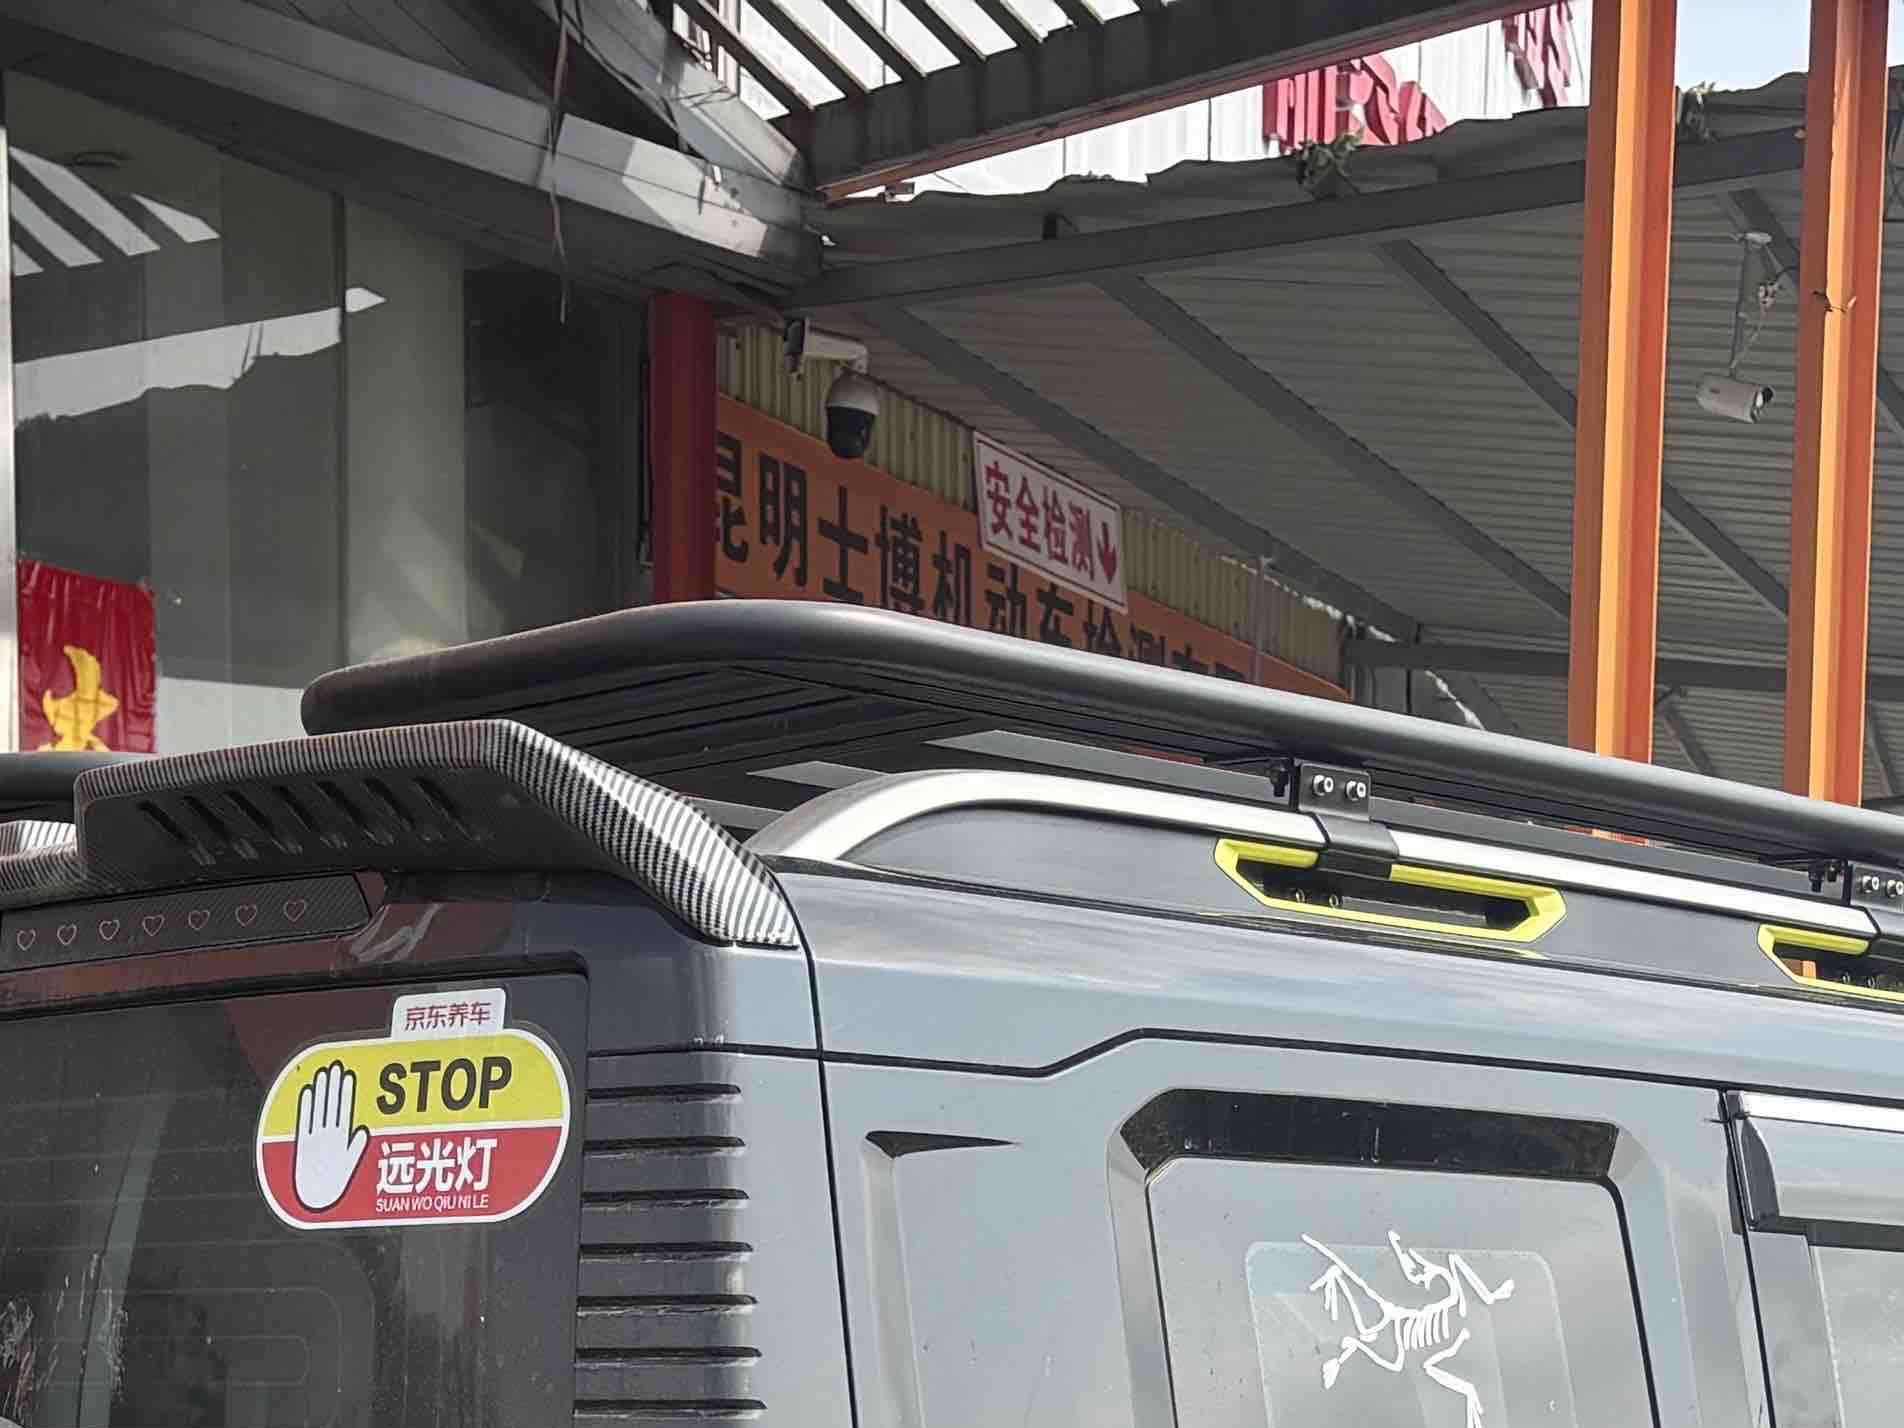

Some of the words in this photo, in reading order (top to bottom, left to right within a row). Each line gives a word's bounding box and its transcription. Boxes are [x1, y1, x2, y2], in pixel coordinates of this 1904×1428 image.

[984, 461, 1095, 582] 安全检测
[404, 1001, 492, 1031] 京东养车
[375, 1055, 513, 1116] STOP
[375, 1136, 498, 1195] 远光灯
[375, 1196, 411, 1213] SUAN
[411, 1196, 433, 1210] WO
[434, 1194, 457, 1213] QIU
